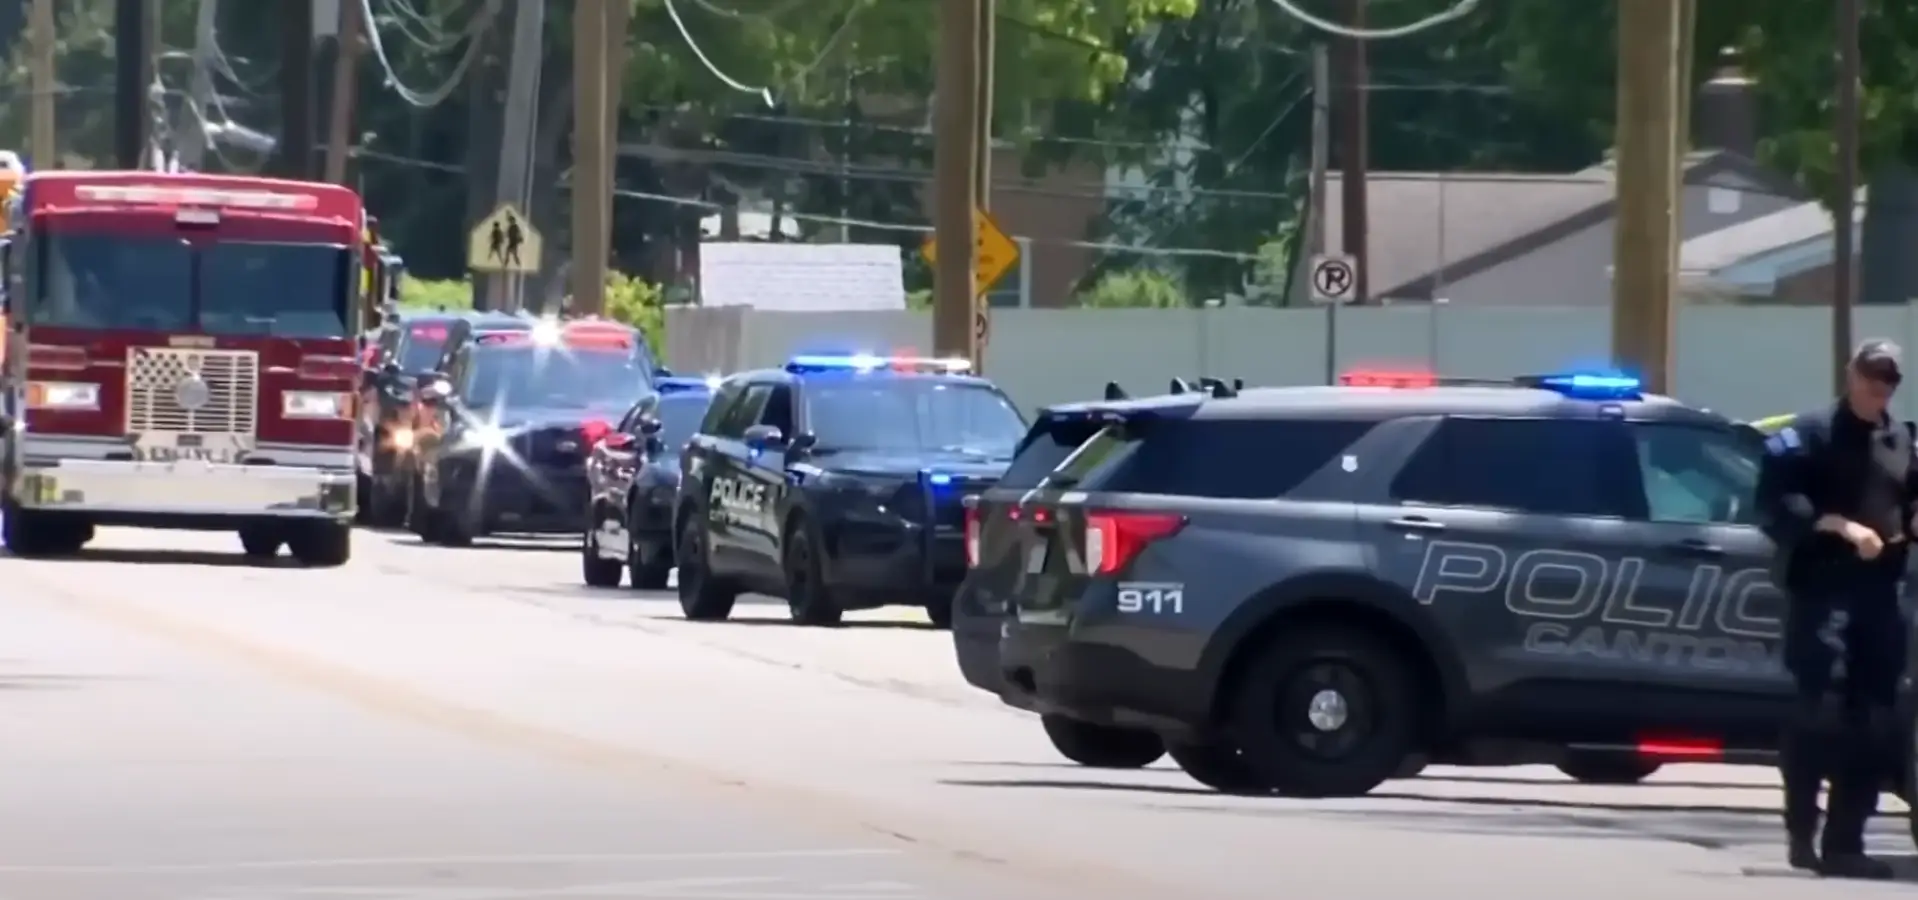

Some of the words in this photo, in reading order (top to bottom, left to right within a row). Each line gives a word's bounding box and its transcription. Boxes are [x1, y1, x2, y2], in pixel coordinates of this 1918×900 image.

[709, 476, 765, 512] POLICE
[1117, 590, 1183, 614] 911
[1412, 541, 1784, 639] POLIC
